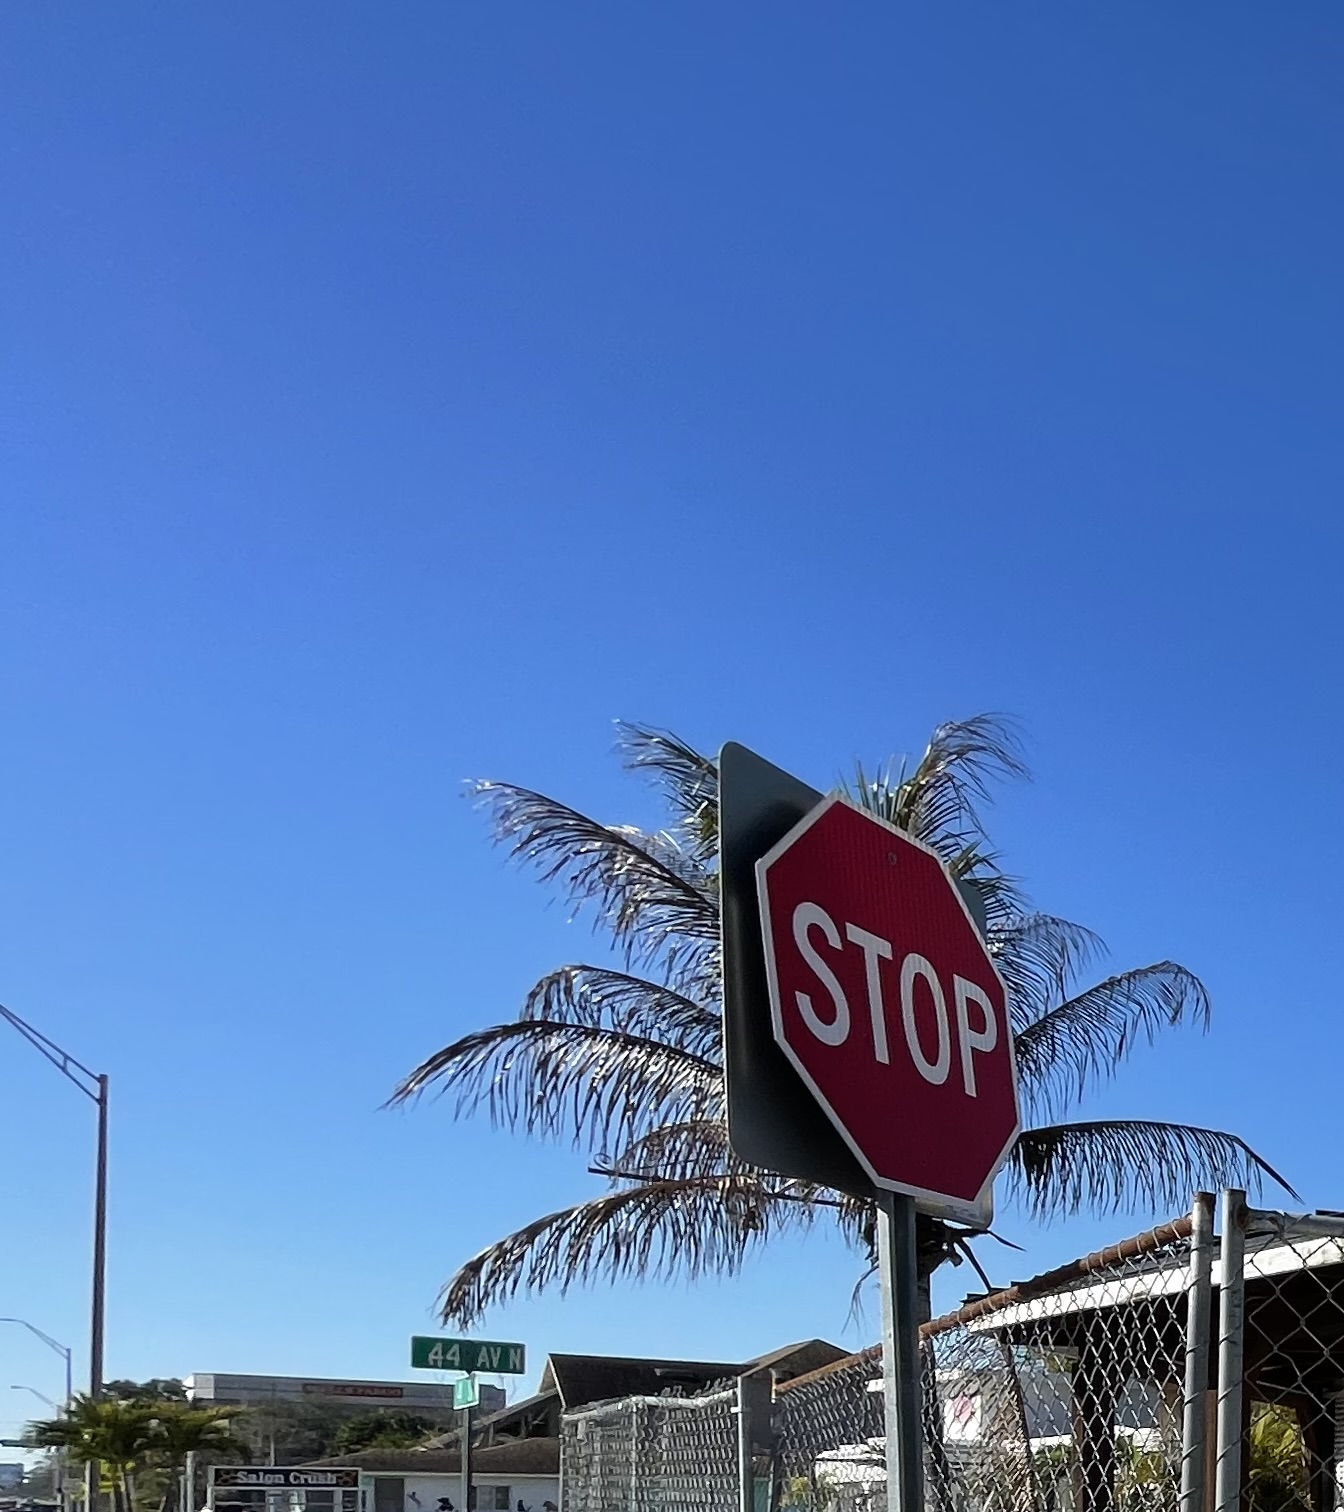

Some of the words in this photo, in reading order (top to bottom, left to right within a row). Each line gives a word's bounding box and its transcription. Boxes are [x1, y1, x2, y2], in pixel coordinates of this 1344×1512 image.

[792, 901, 998, 1098] STOP
[427, 1342, 461, 1368] 44
[476, 1346, 502, 1369] AV
[509, 1347, 521, 1370] N
[236, 1471, 285, 1484] Salon
[289, 1471, 337, 1485] Crush
